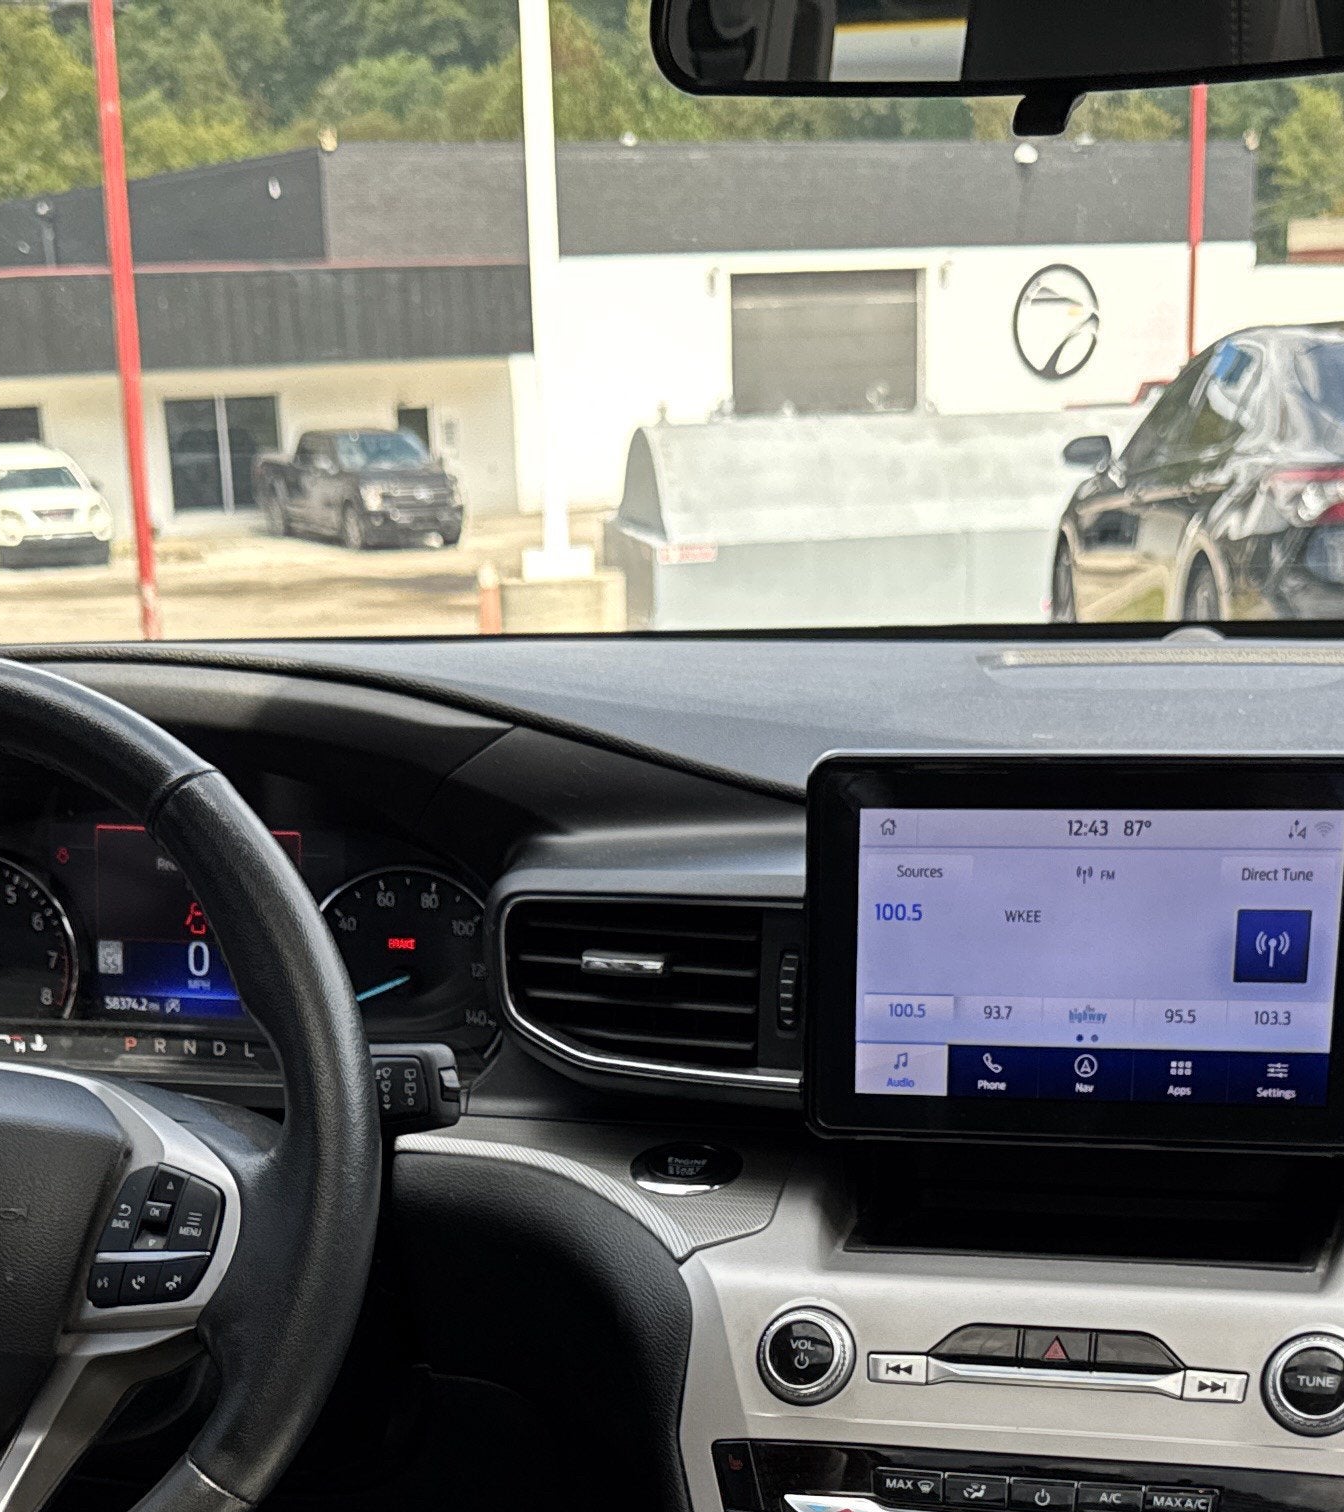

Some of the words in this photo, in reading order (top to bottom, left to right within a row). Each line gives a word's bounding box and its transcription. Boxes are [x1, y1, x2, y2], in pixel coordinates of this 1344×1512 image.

[1067, 818, 1109, 838] 12:43
[1123, 818, 1152, 838] 87°
[896, 864, 943, 880] Sources
[1100, 870, 1116, 881] FM
[1241, 866, 1277, 883] Direct
[1281, 868, 1313, 883] Tune
[376, 890, 395, 907] 60
[420, 892, 439, 909] 80
[874, 902, 923, 923] 100.5
[1004, 908, 1042, 925] WKEE
[188, 941, 210, 976] 0
[888, 1002, 926, 1019] 100.5
[983, 1004, 1013, 1021] 93.7
[1164, 1008, 1196, 1025] 95.5
[1254, 1009, 1291, 1027] 103.3
[124, 1036, 137, 1051] P
[154, 1038, 166, 1053] R
[184, 1039, 196, 1055] N
[213, 1041, 227, 1056] D
[244, 1043, 255, 1058] L
[886, 1076, 915, 1089] Audio
[977, 1079, 1006, 1092] Phone
[1075, 1081, 1094, 1093] Nav
[1167, 1084, 1192, 1098] Apps
[1256, 1086, 1296, 1100] Settings
[111, 1218, 131, 1229] BACK
[178, 1225, 203, 1237] MENU
[789, 1339, 816, 1351] VOL
[1296, 1374, 1335, 1389] TUNE
[885, 1478, 913, 1491] MAX
[1099, 1492, 1122, 1505] A/C
[1153, 1495, 1182, 1508] MAX
[1184, 1498, 1208, 1511] A/C
